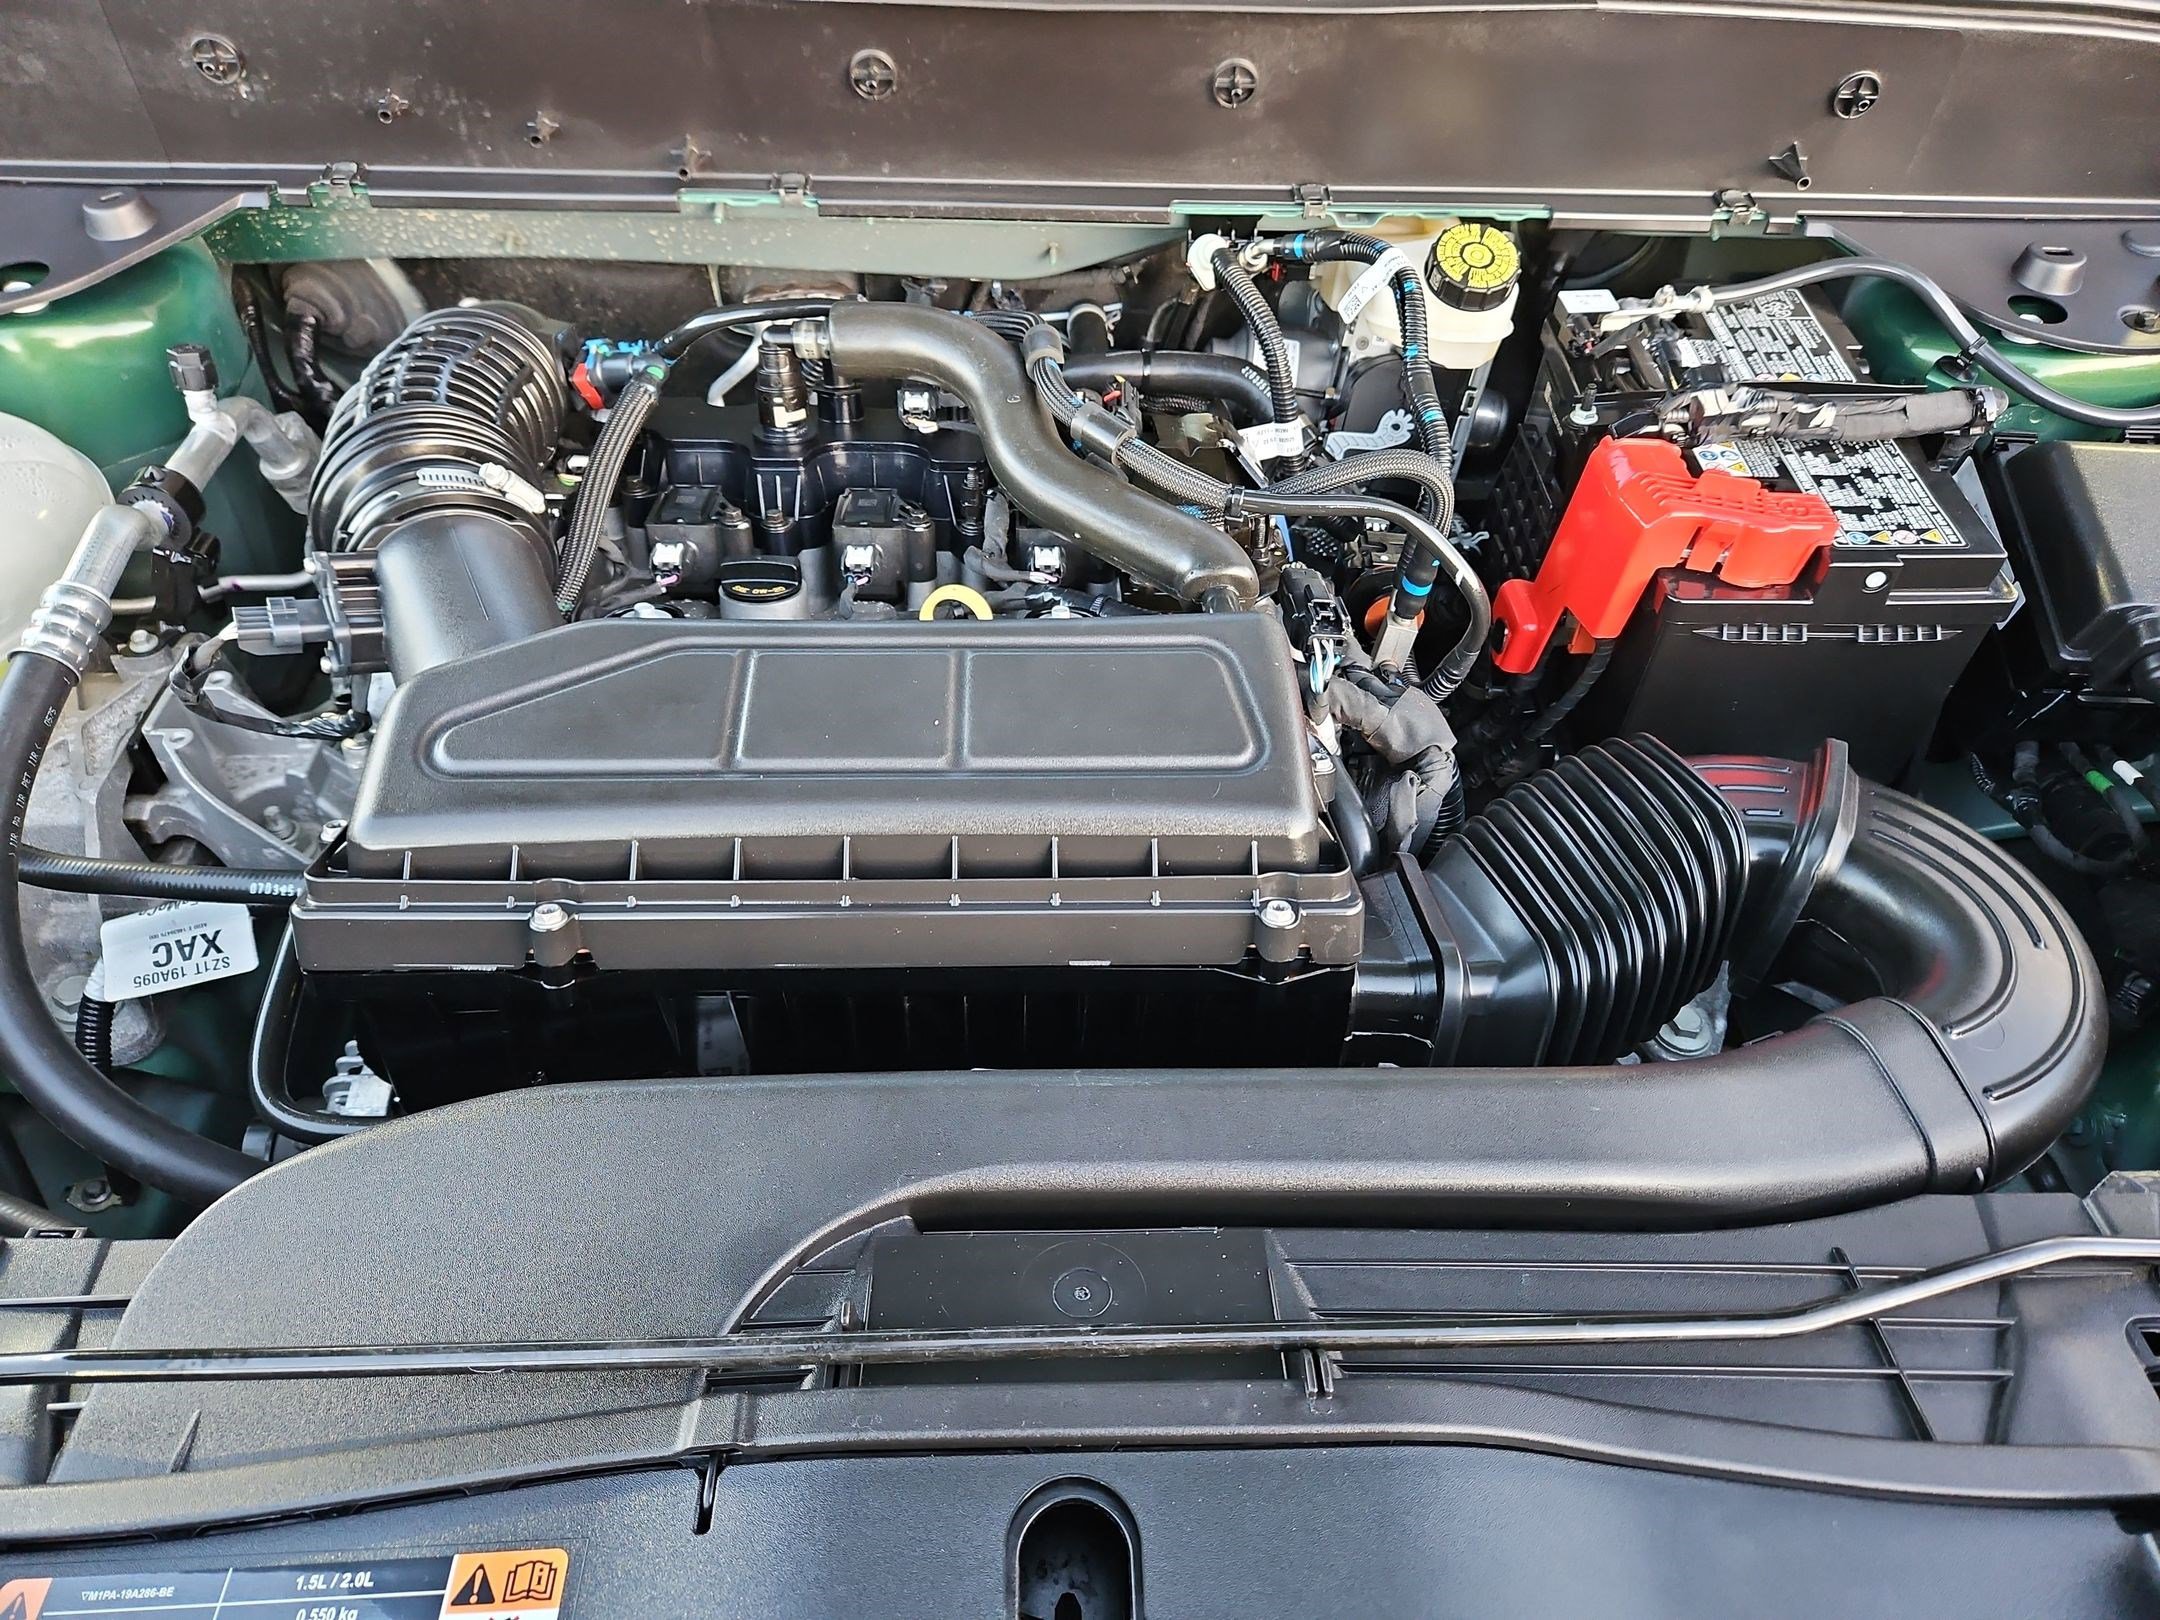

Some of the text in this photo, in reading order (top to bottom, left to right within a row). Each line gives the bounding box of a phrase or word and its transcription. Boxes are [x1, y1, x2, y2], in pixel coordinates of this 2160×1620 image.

[21, 771, 32, 789] PET
[152, 929, 224, 968] XAC
[133, 956, 231, 988] SZ1T 19A095
[296, 1571, 374, 1591] 1.5L / 2.0L
[338, 1606, 359, 1620] kg
